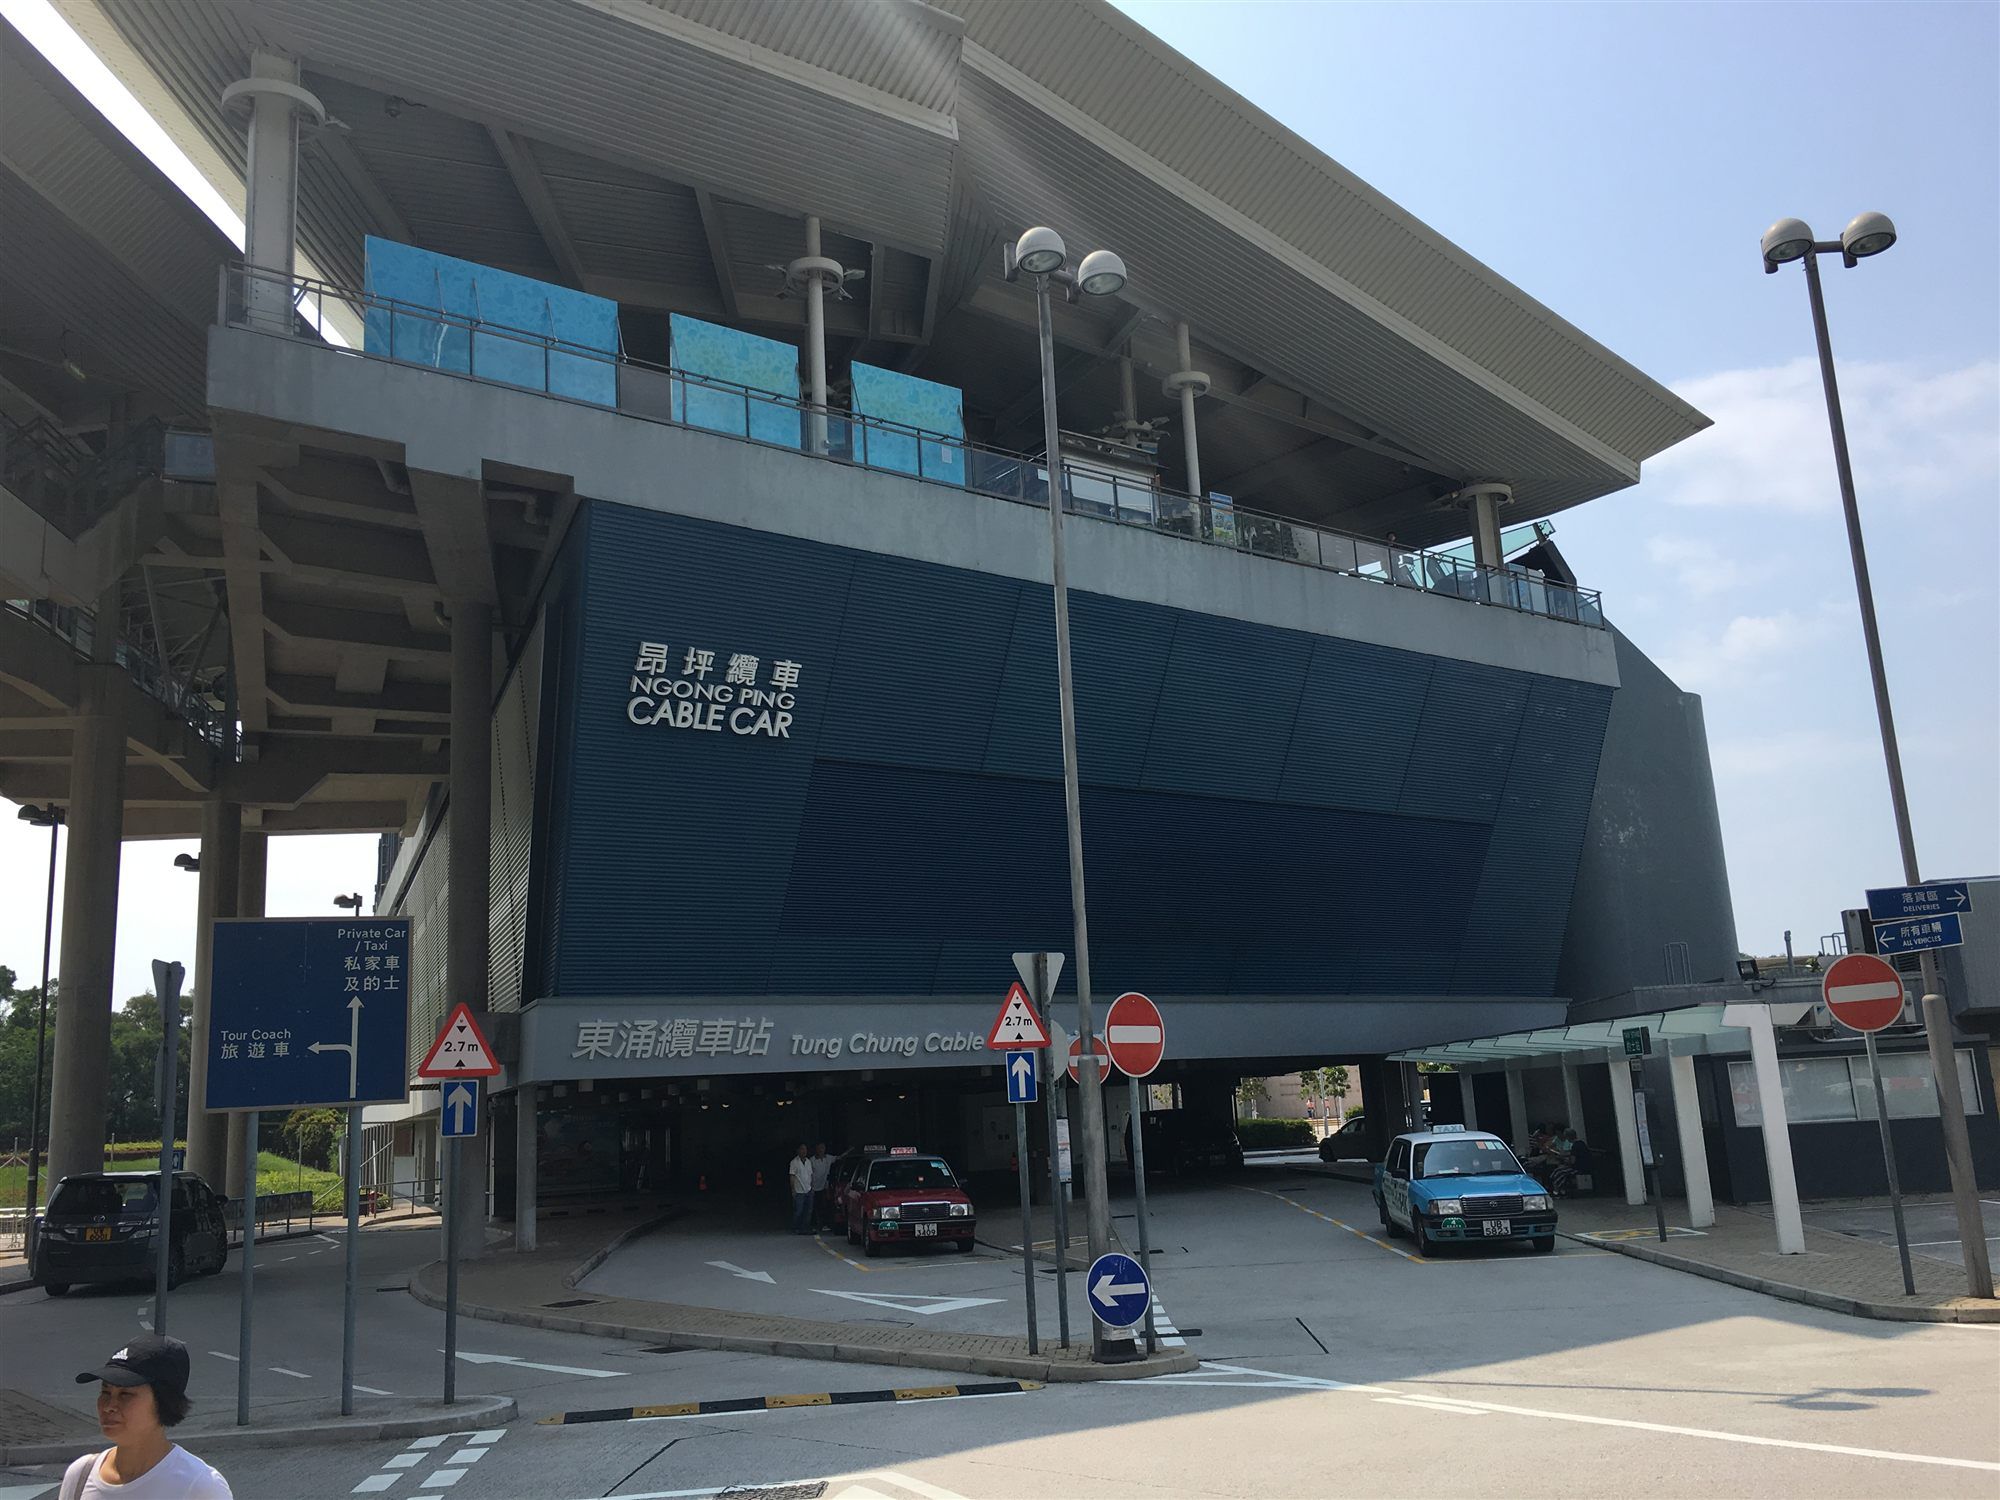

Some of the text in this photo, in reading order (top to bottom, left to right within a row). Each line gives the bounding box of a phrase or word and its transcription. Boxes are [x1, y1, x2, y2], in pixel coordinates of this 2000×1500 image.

[635, 641, 802, 690] 昂坪纜車
[630, 675, 795, 709] NGONG PING
[627, 696, 793, 738] CABLE CAR
[1903, 904, 1940, 912] DELIVERIES
[338, 927, 406, 939] Private Car
[1914, 935, 1942, 945] VEHICLES
[363, 940, 388, 950] Taxi
[344, 955, 400, 971] 私家車
[343, 975, 400, 991] 及的士
[220, 1028, 291, 1041] Tour Coach
[572, 1017, 775, 1060] 東涌纜車站
[220, 1041, 290, 1060] 旅遊車
[791, 1032, 986, 1058] Tung Chung Cable
[1436, 1125, 1463, 1133] TAXI
